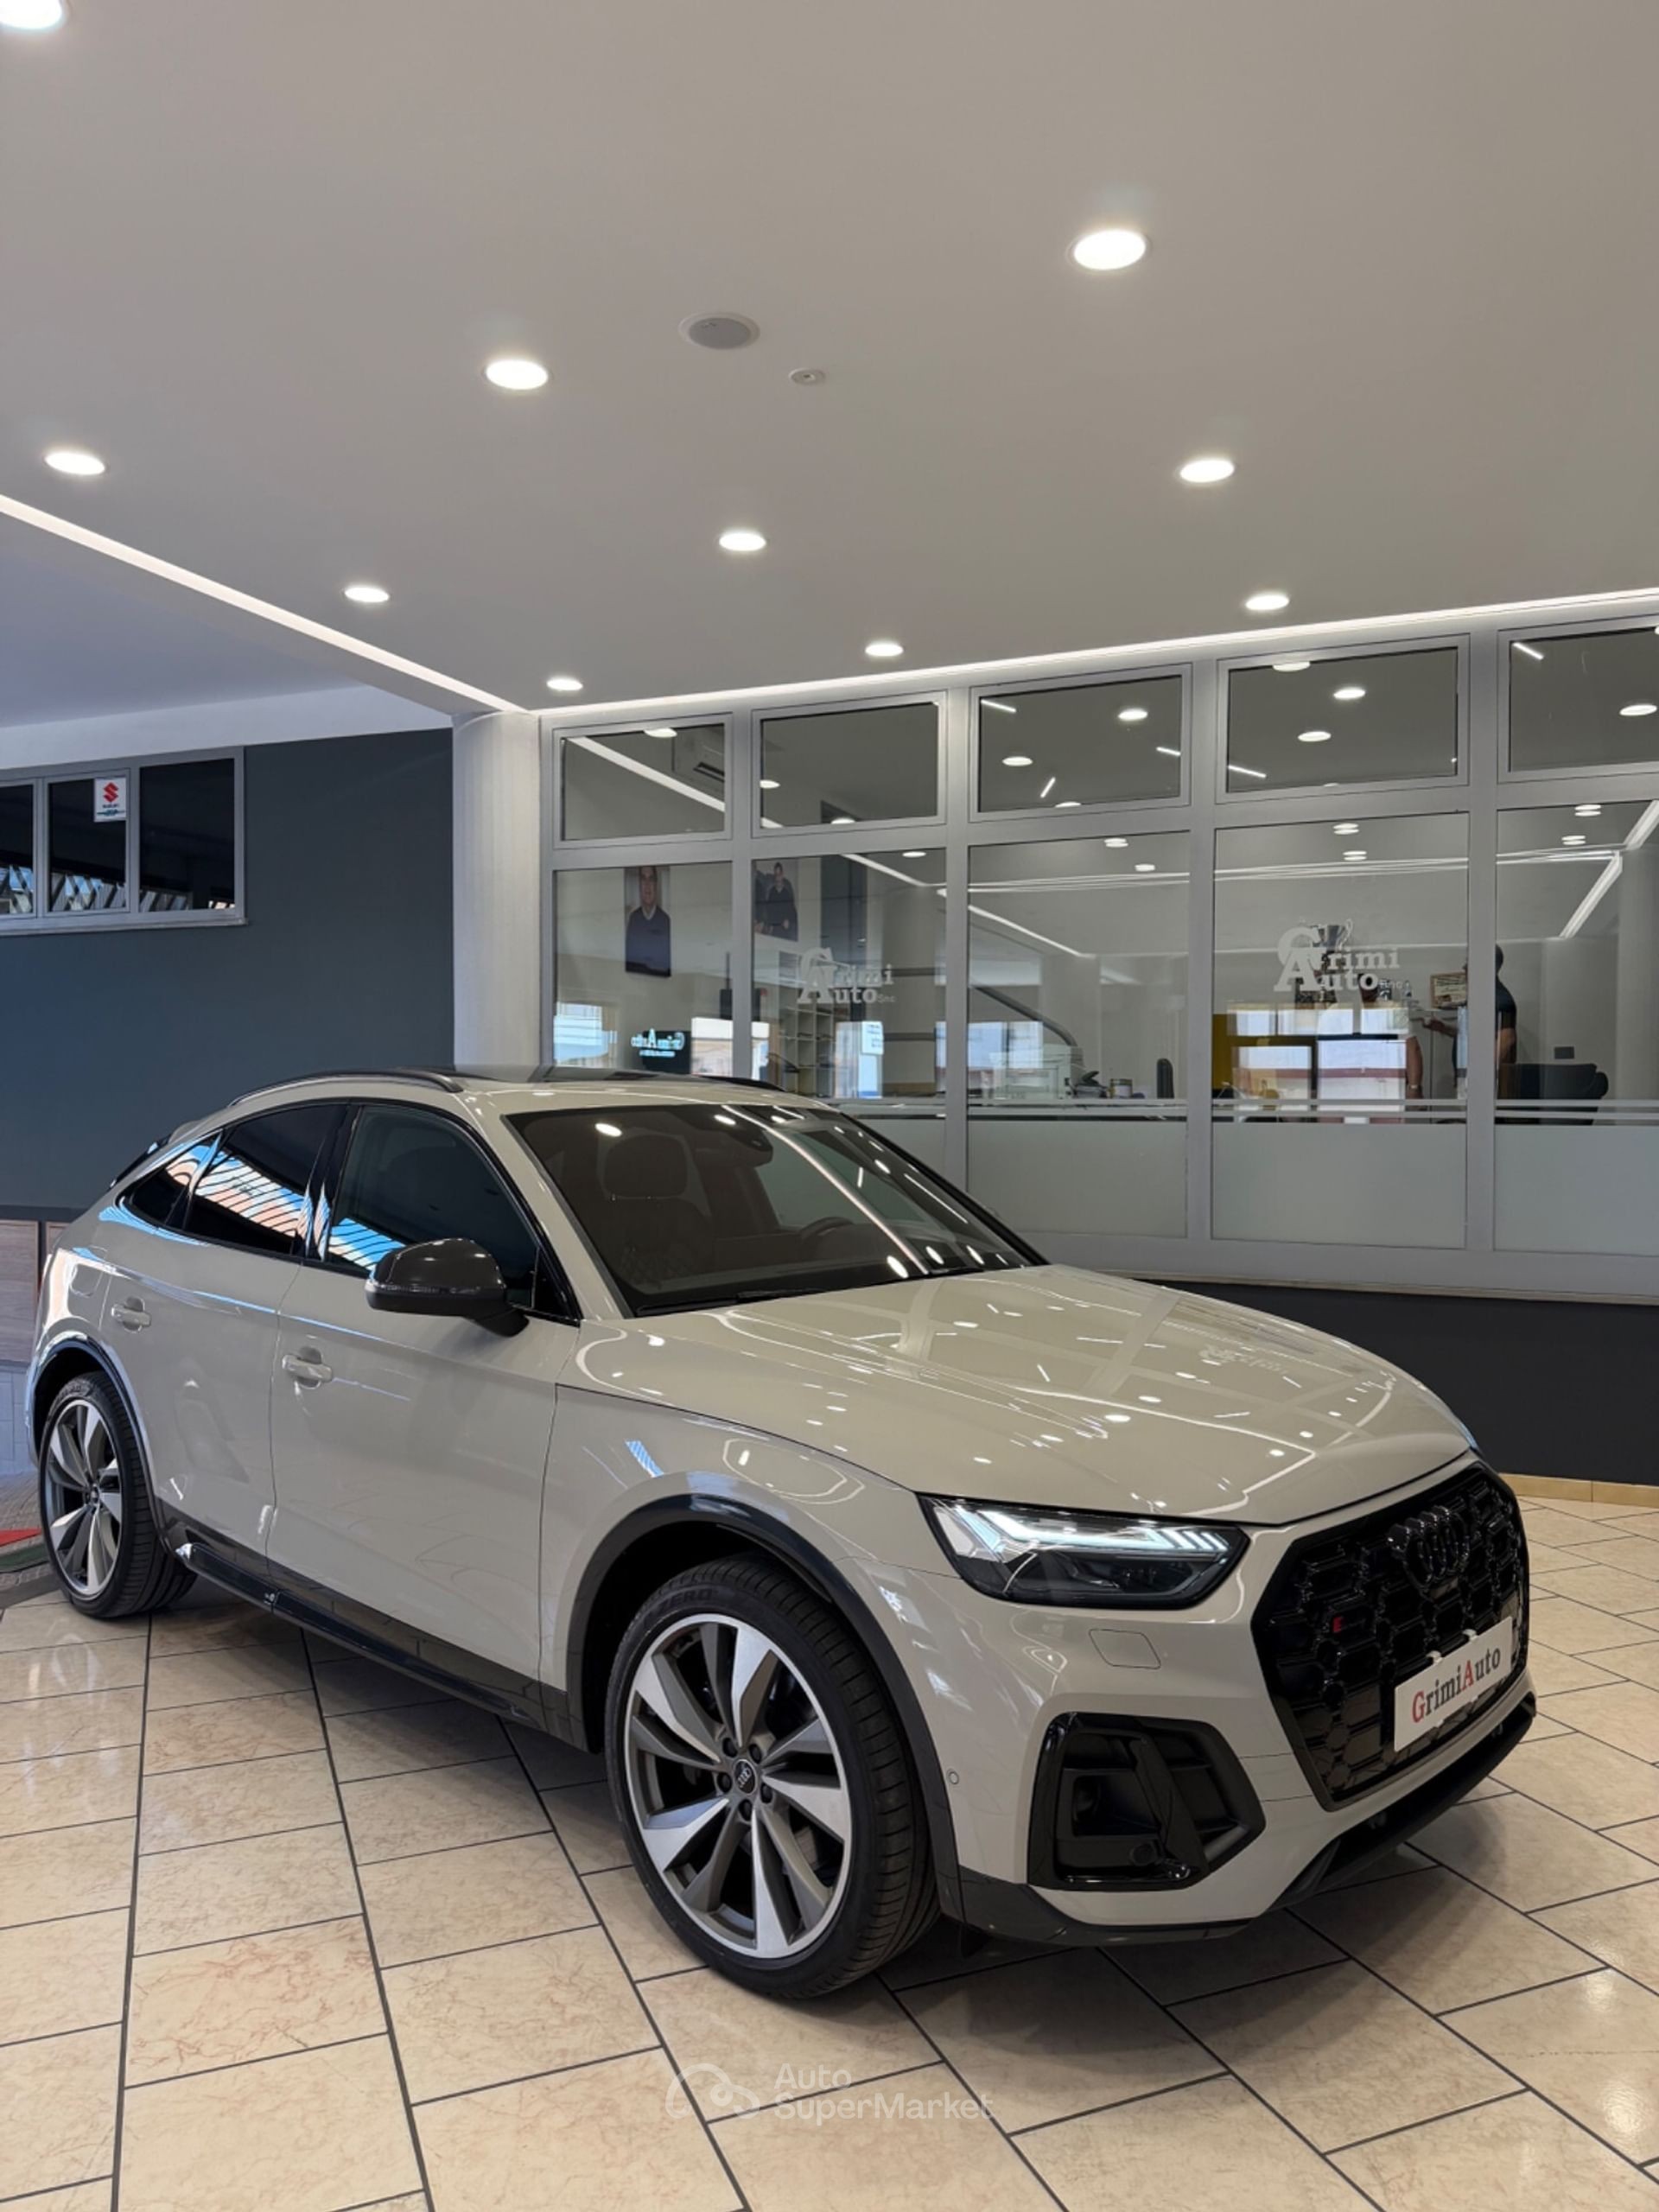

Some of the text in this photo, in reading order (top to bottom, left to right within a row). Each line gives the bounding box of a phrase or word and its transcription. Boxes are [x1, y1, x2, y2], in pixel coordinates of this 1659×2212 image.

[1277, 926, 1400, 970] Grimi
[797, 965, 878, 1004] Auto
[1274, 950, 1379, 992] Auto
[1412, 1647, 1501, 1723] GrimiAuto
